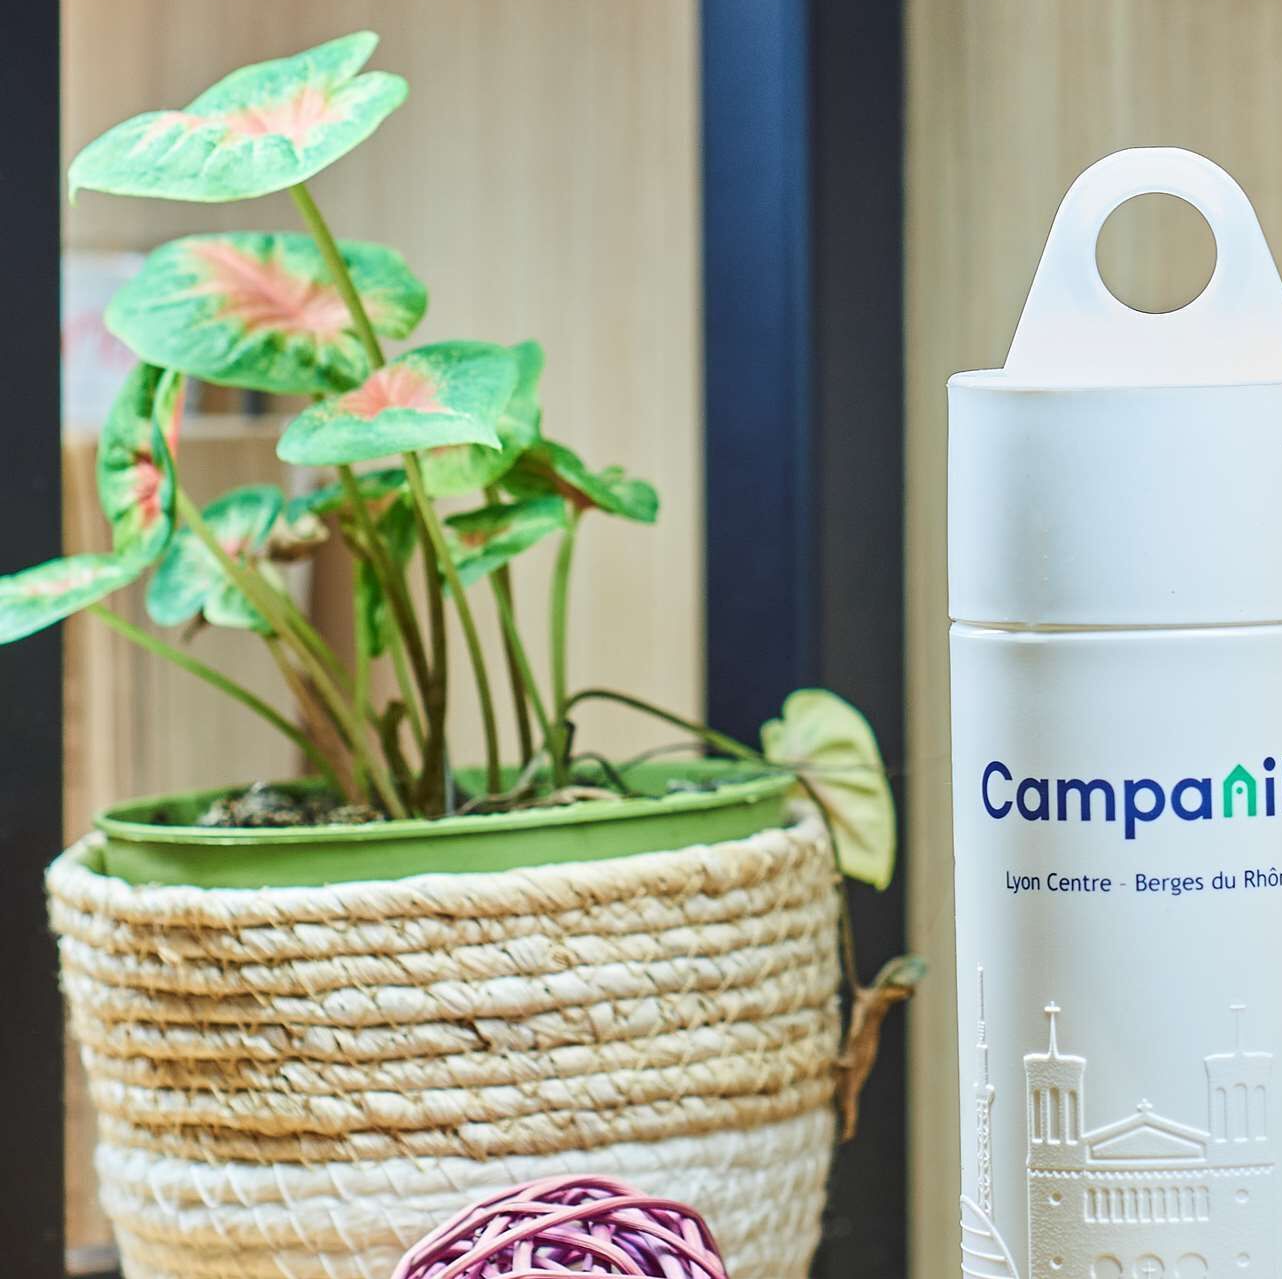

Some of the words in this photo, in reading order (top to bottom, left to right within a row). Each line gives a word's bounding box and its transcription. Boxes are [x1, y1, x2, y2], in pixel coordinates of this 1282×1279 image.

[1005, 870, 1041, 895] Lyon
[1046, 872, 1112, 893] Centre
[1135, 872, 1205, 897] Berges
[1211, 870, 1237, 891] du
